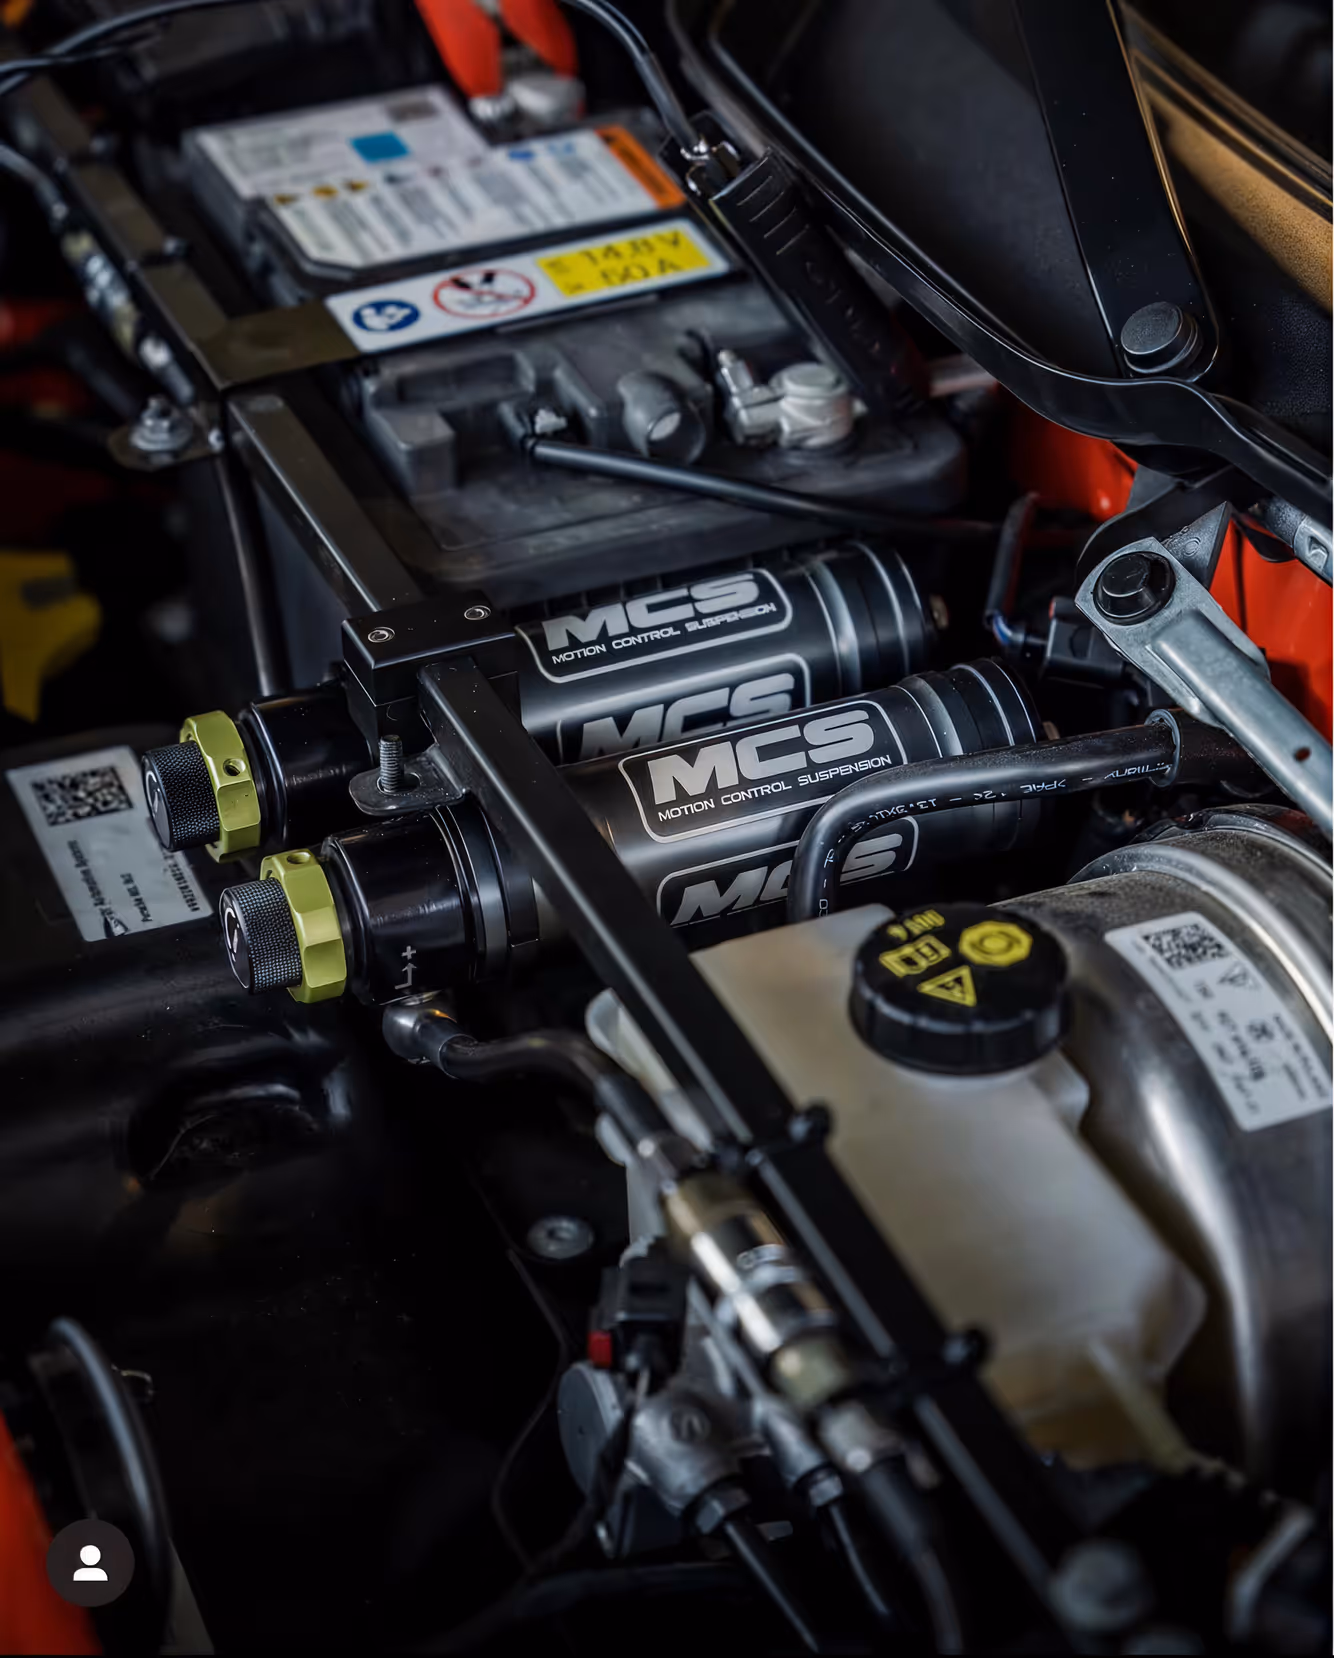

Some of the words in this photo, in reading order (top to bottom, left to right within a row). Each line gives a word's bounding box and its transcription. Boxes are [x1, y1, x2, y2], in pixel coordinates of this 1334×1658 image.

[541, 573, 759, 651] MCS
[552, 643, 607, 664] MOTION
[612, 626, 681, 650] CONTROL
[580, 672, 795, 758] MCS
[647, 709, 875, 805] MCS
[657, 798, 715, 822] MOTION
[720, 780, 792, 805] CONTROL
[797, 754, 892, 787] SUSPENSION
